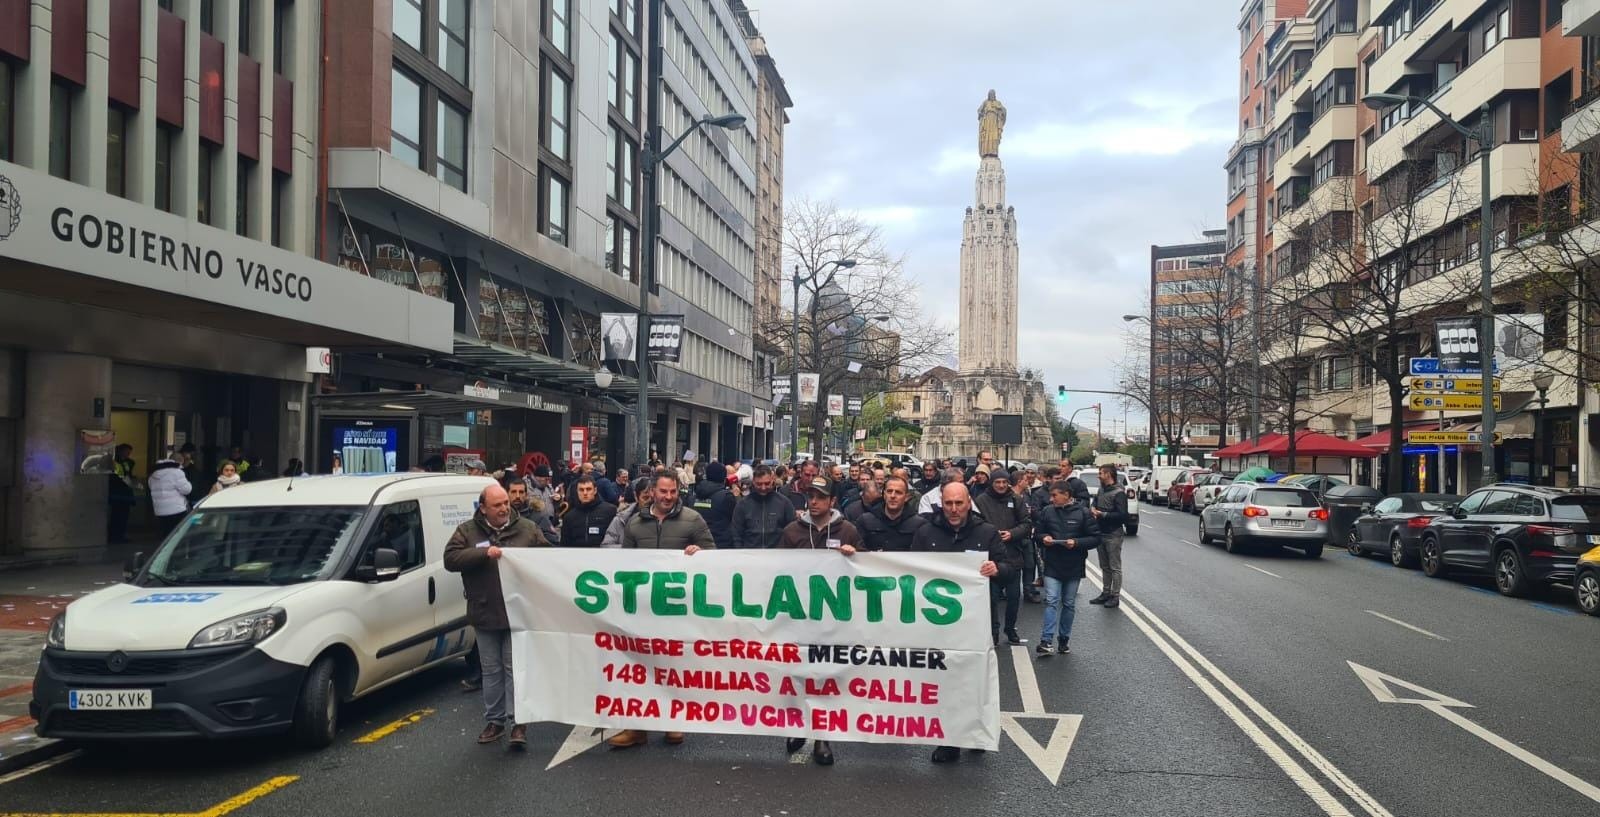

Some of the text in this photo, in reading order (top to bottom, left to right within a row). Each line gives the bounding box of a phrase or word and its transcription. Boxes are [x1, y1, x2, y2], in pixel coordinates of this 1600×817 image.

[51, 207, 311, 301] GOBIERNO VASCO
[574, 570, 964, 626] STELLANTIS
[594, 632, 948, 671] QUIERE CERRAR MECANER
[79, 693, 146, 707] 4302 KVK
[602, 663, 940, 705] 148 FAMILIAS A LA CALLE
[594, 694, 945, 740] PARA PRODUCIR EN CHINA
